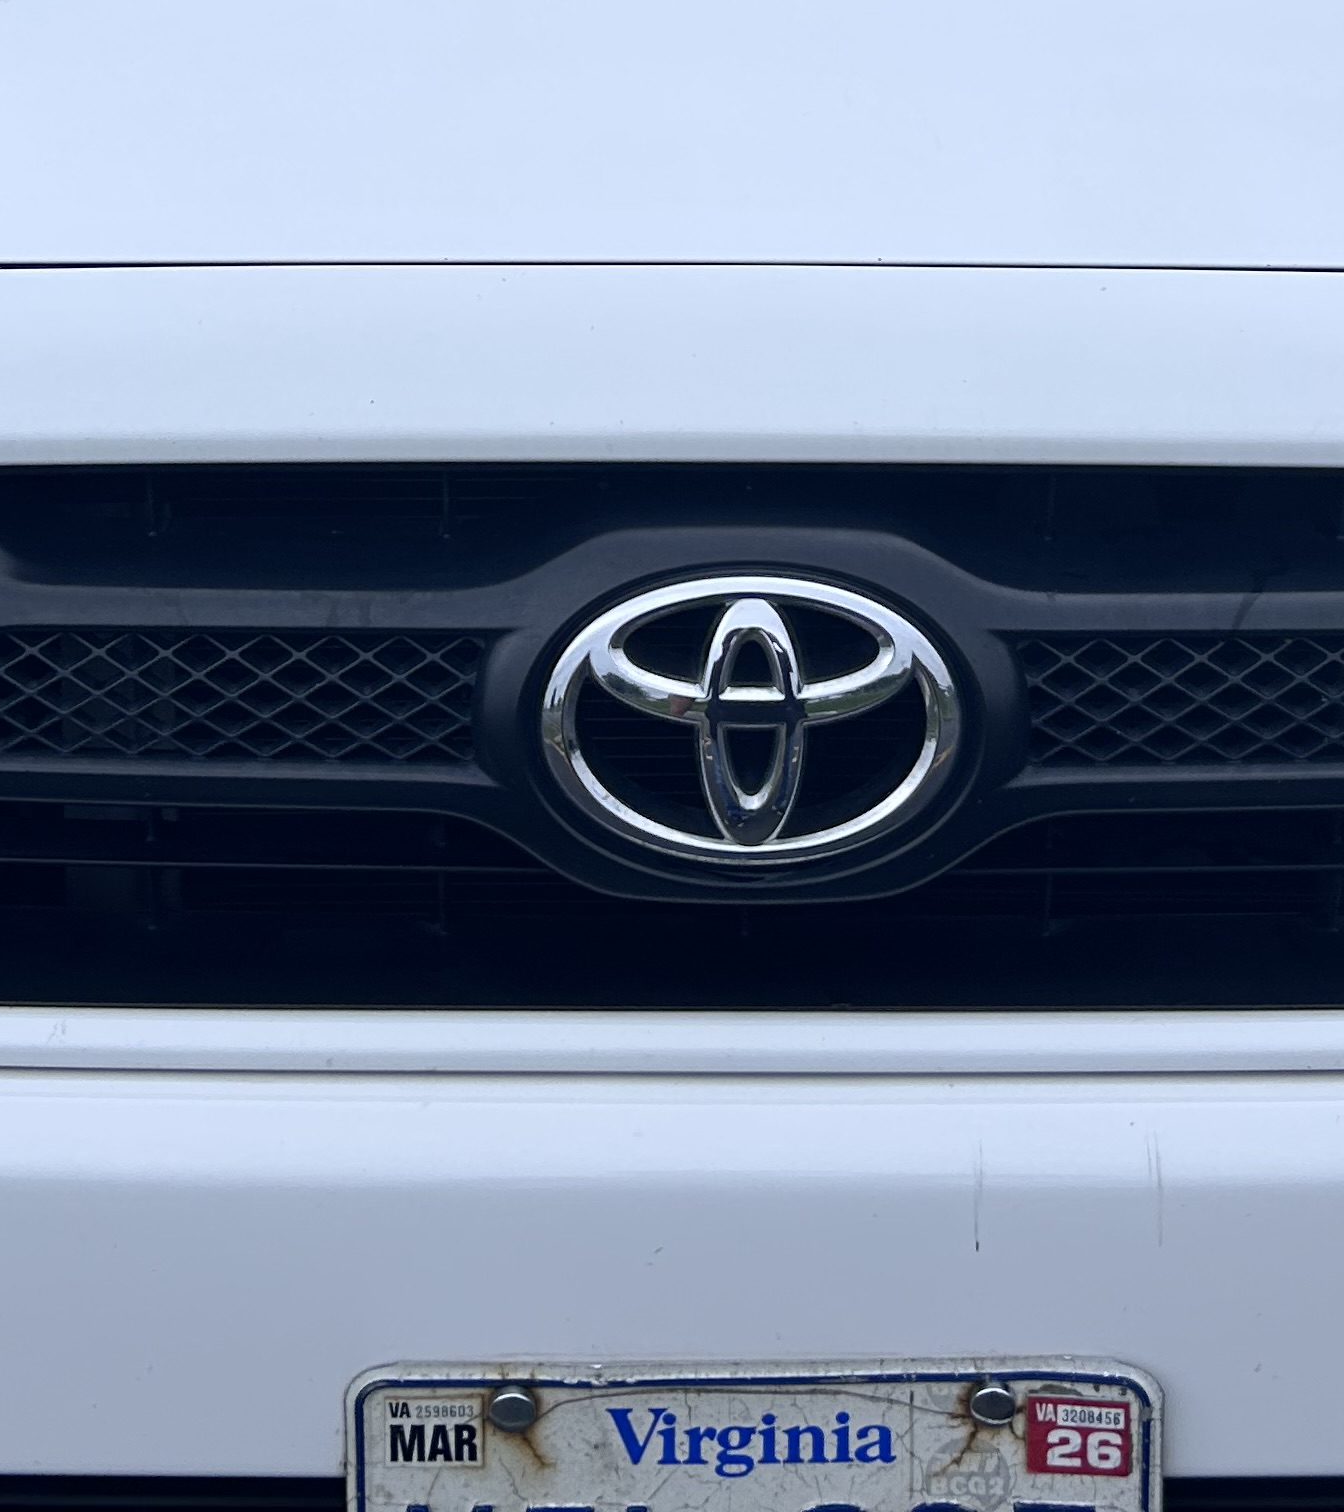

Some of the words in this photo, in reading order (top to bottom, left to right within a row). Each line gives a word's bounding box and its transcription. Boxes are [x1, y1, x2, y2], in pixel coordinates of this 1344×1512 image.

[389, 1402, 411, 1418] VA
[416, 1405, 474, 1418] 2598603
[1036, 1402, 1056, 1422] VA
[1062, 1408, 1121, 1425] 3208456
[390, 1424, 477, 1462] MAR
[606, 1407, 897, 1477] Virginia
[1046, 1428, 1122, 1469] 26
